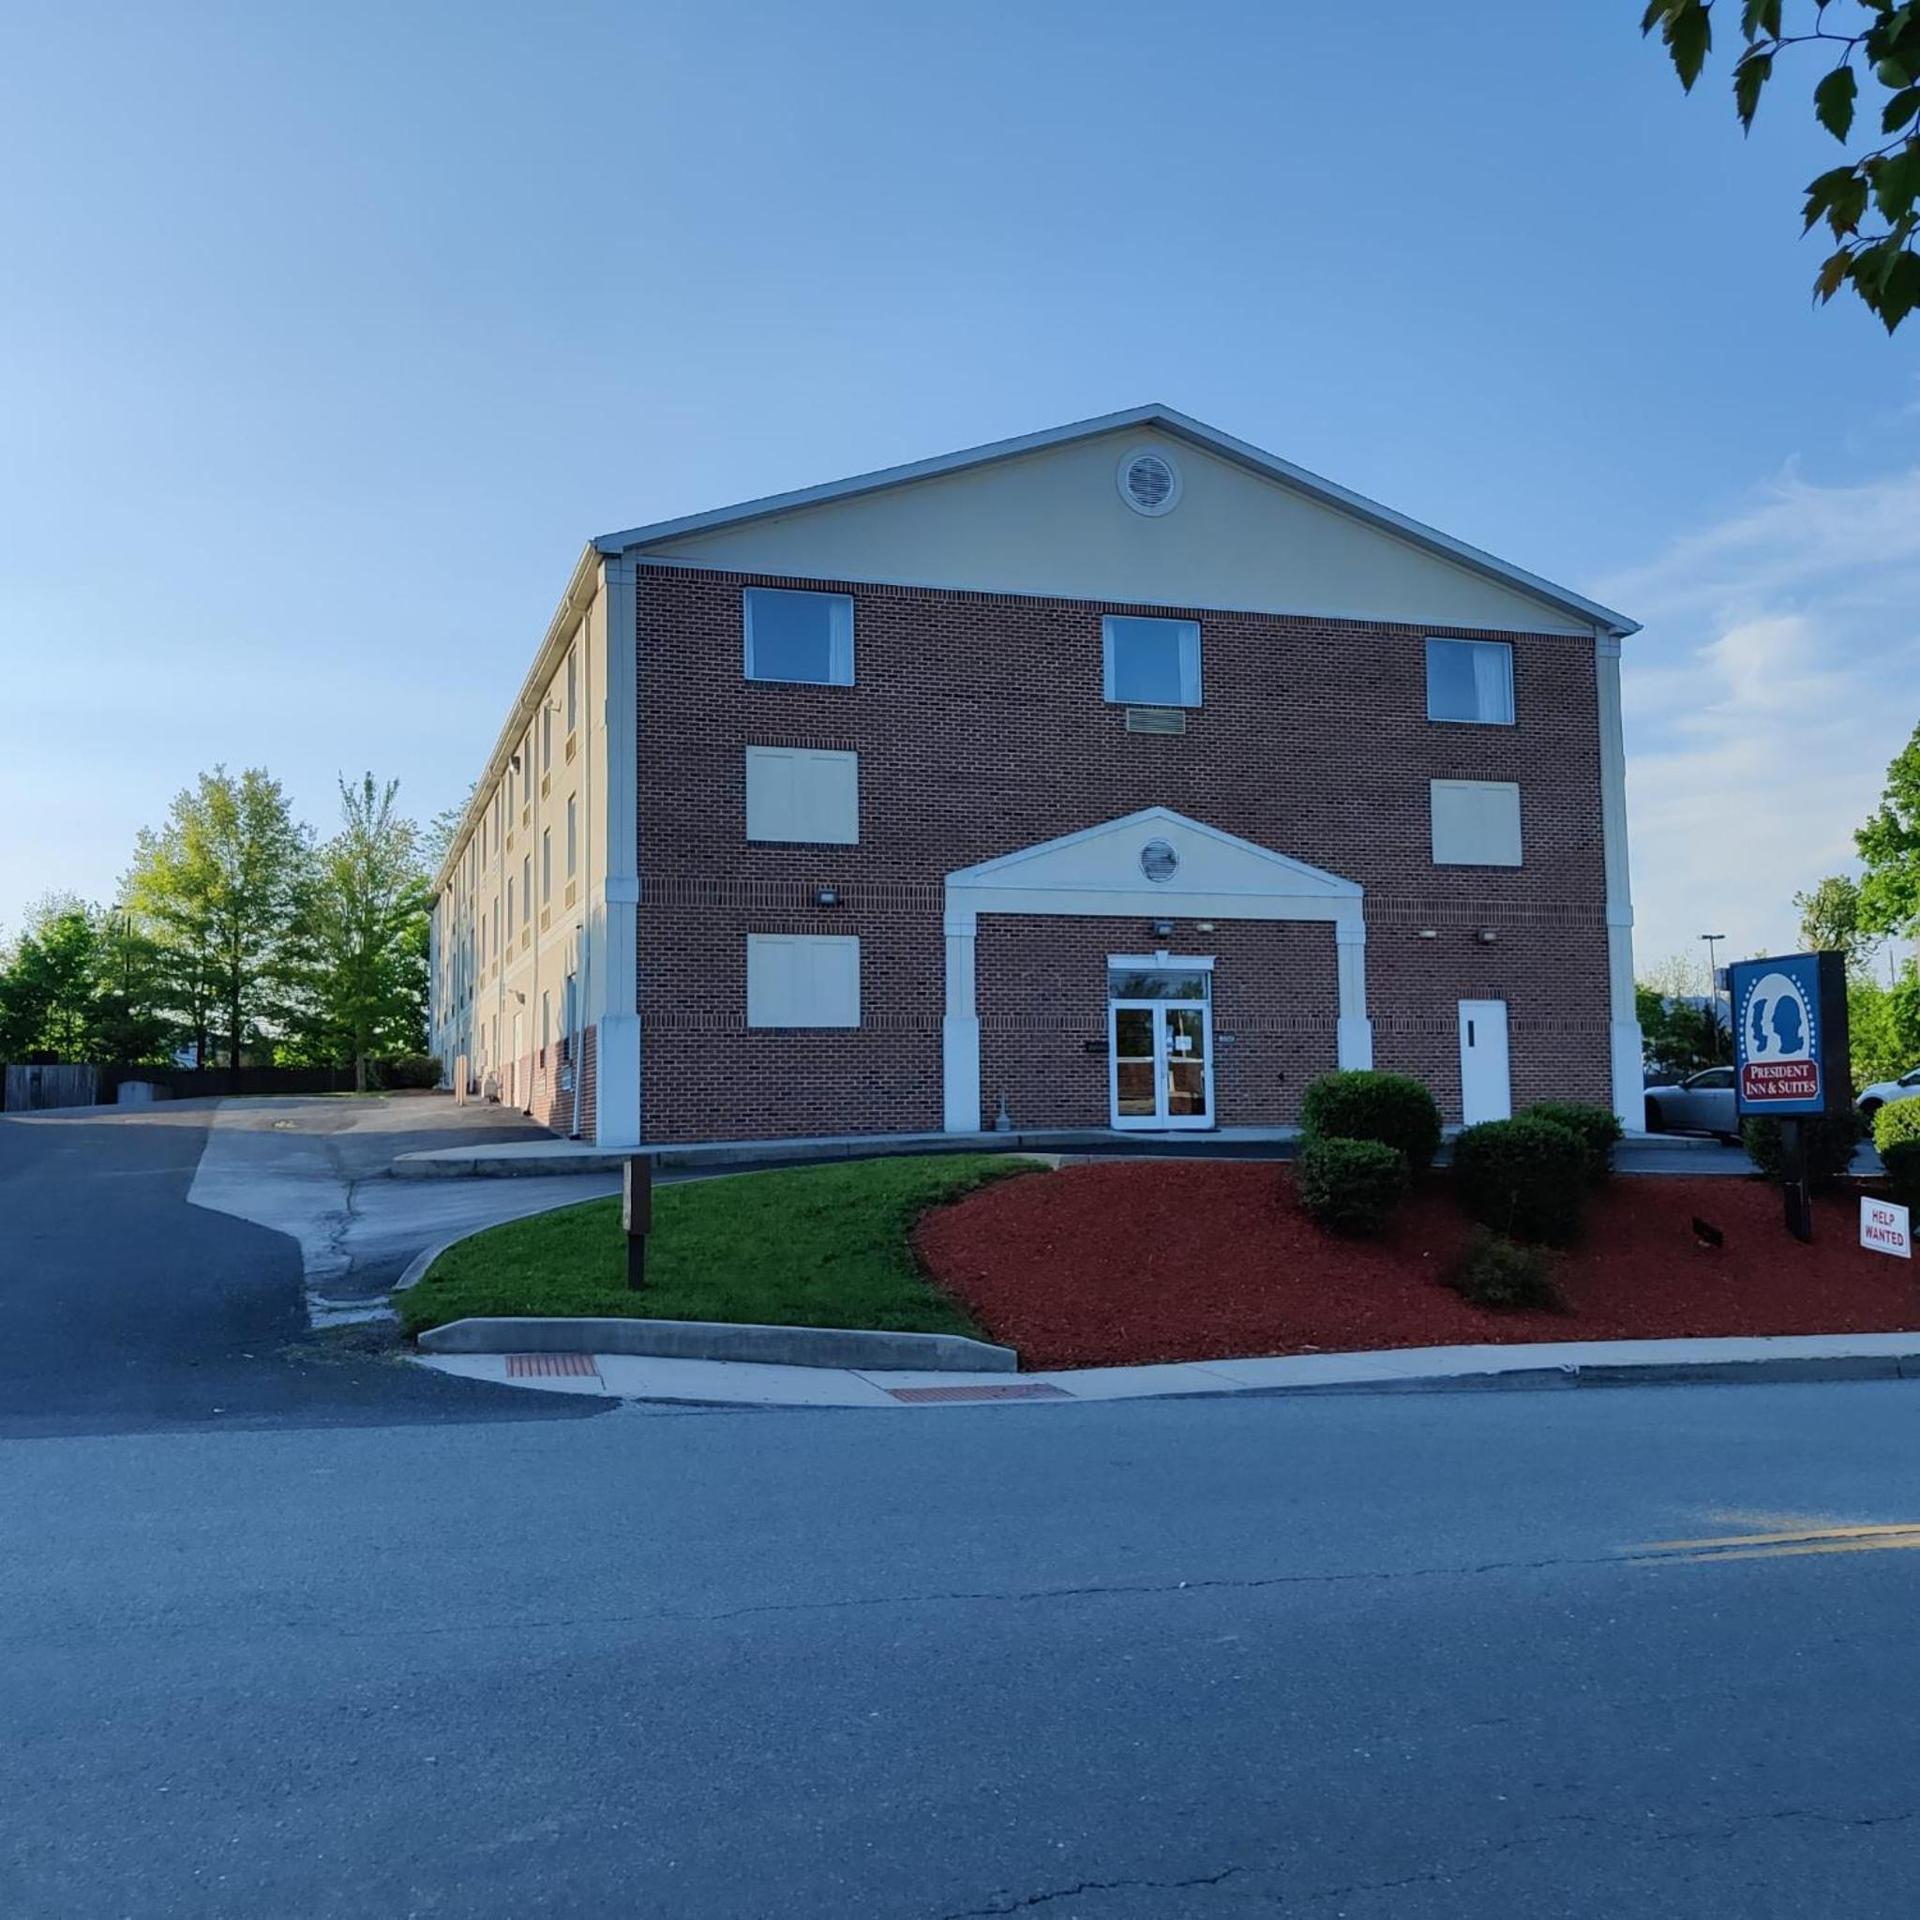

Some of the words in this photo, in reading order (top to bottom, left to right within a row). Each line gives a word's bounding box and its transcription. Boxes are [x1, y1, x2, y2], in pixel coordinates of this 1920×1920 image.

[1751, 1065, 1808, 1079] PRESIDENT
[1746, 1082, 1766, 1095] INN
[1768, 1082, 1776, 1094] &
[1778, 1080, 1816, 1094] SUITES
[1872, 1209, 1895, 1226] HELP
[1865, 1225, 1904, 1246] WANTED
